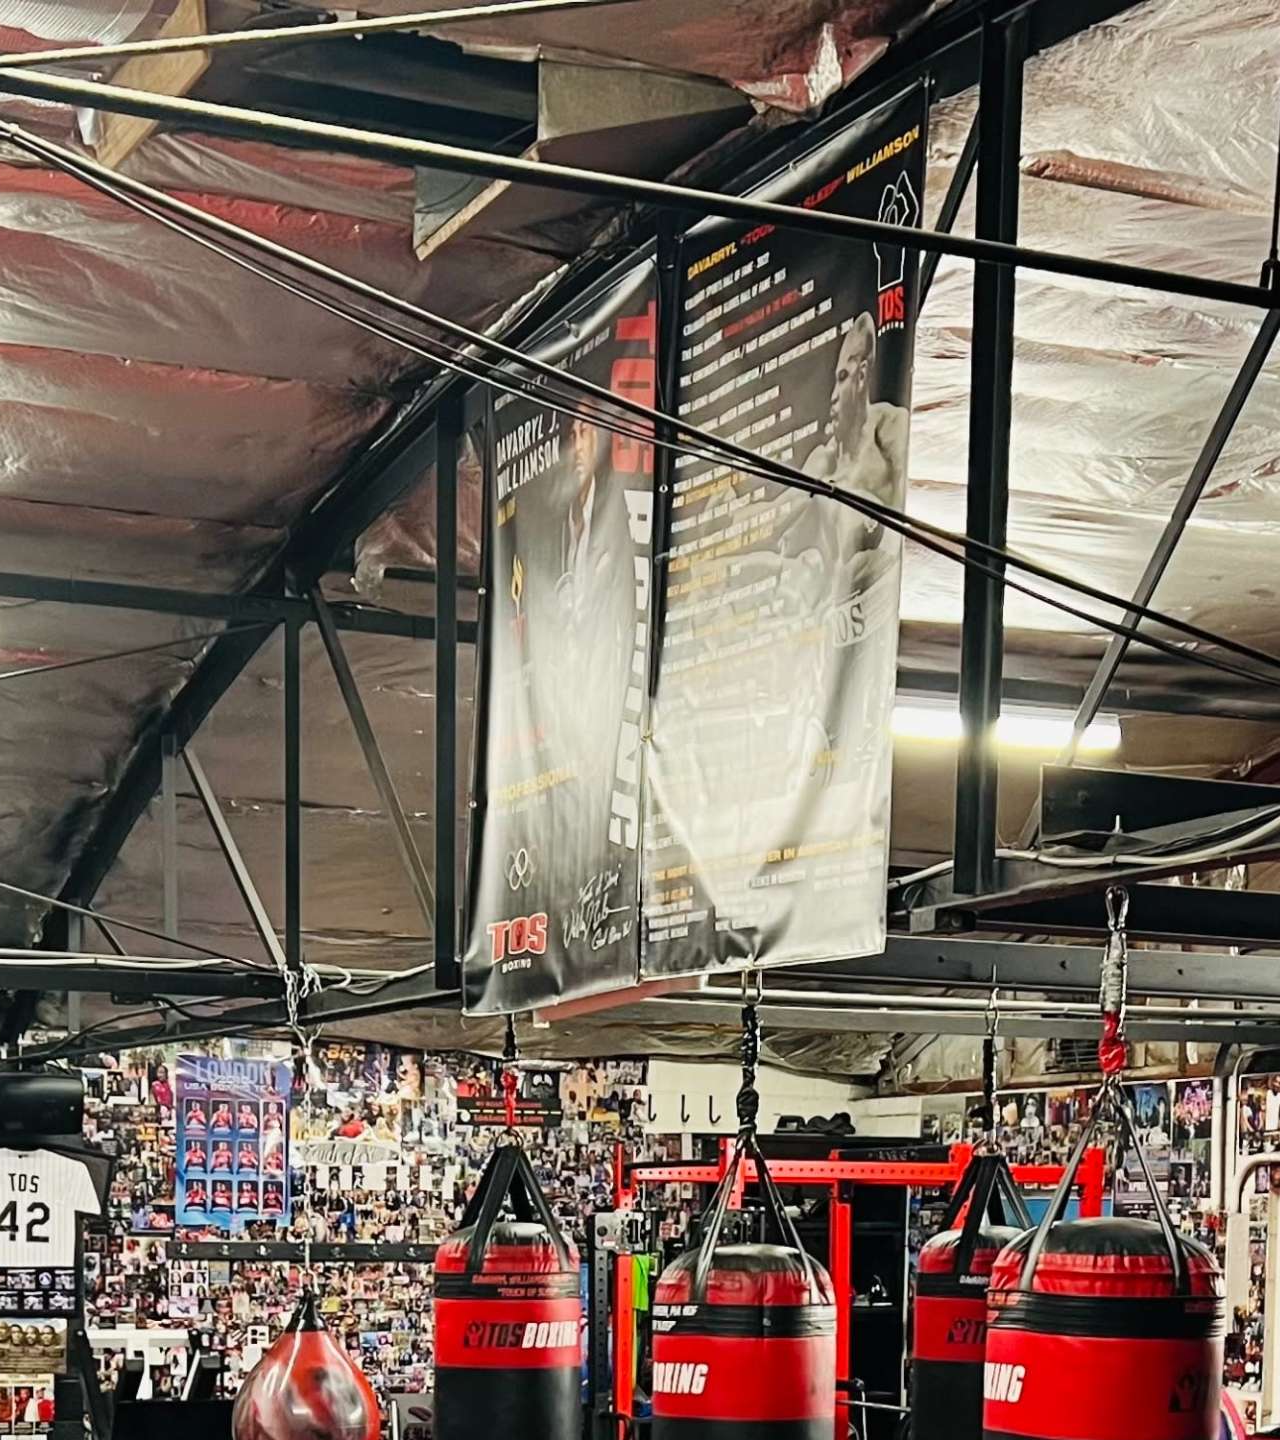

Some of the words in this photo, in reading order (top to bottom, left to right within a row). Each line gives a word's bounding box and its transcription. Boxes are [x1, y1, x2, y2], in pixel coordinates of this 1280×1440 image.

[687, 241, 738, 281] DAVARRYL
[847, 124, 920, 184] WILLIAMSON
[878, 285, 904, 327] TOS
[497, 414, 544, 468] DAVARRYL
[549, 410, 560, 434] J.
[497, 436, 560, 500] WILLIAMSON
[486, 912, 548, 965] TOS
[8, 1173, 40, 1193] TOS
